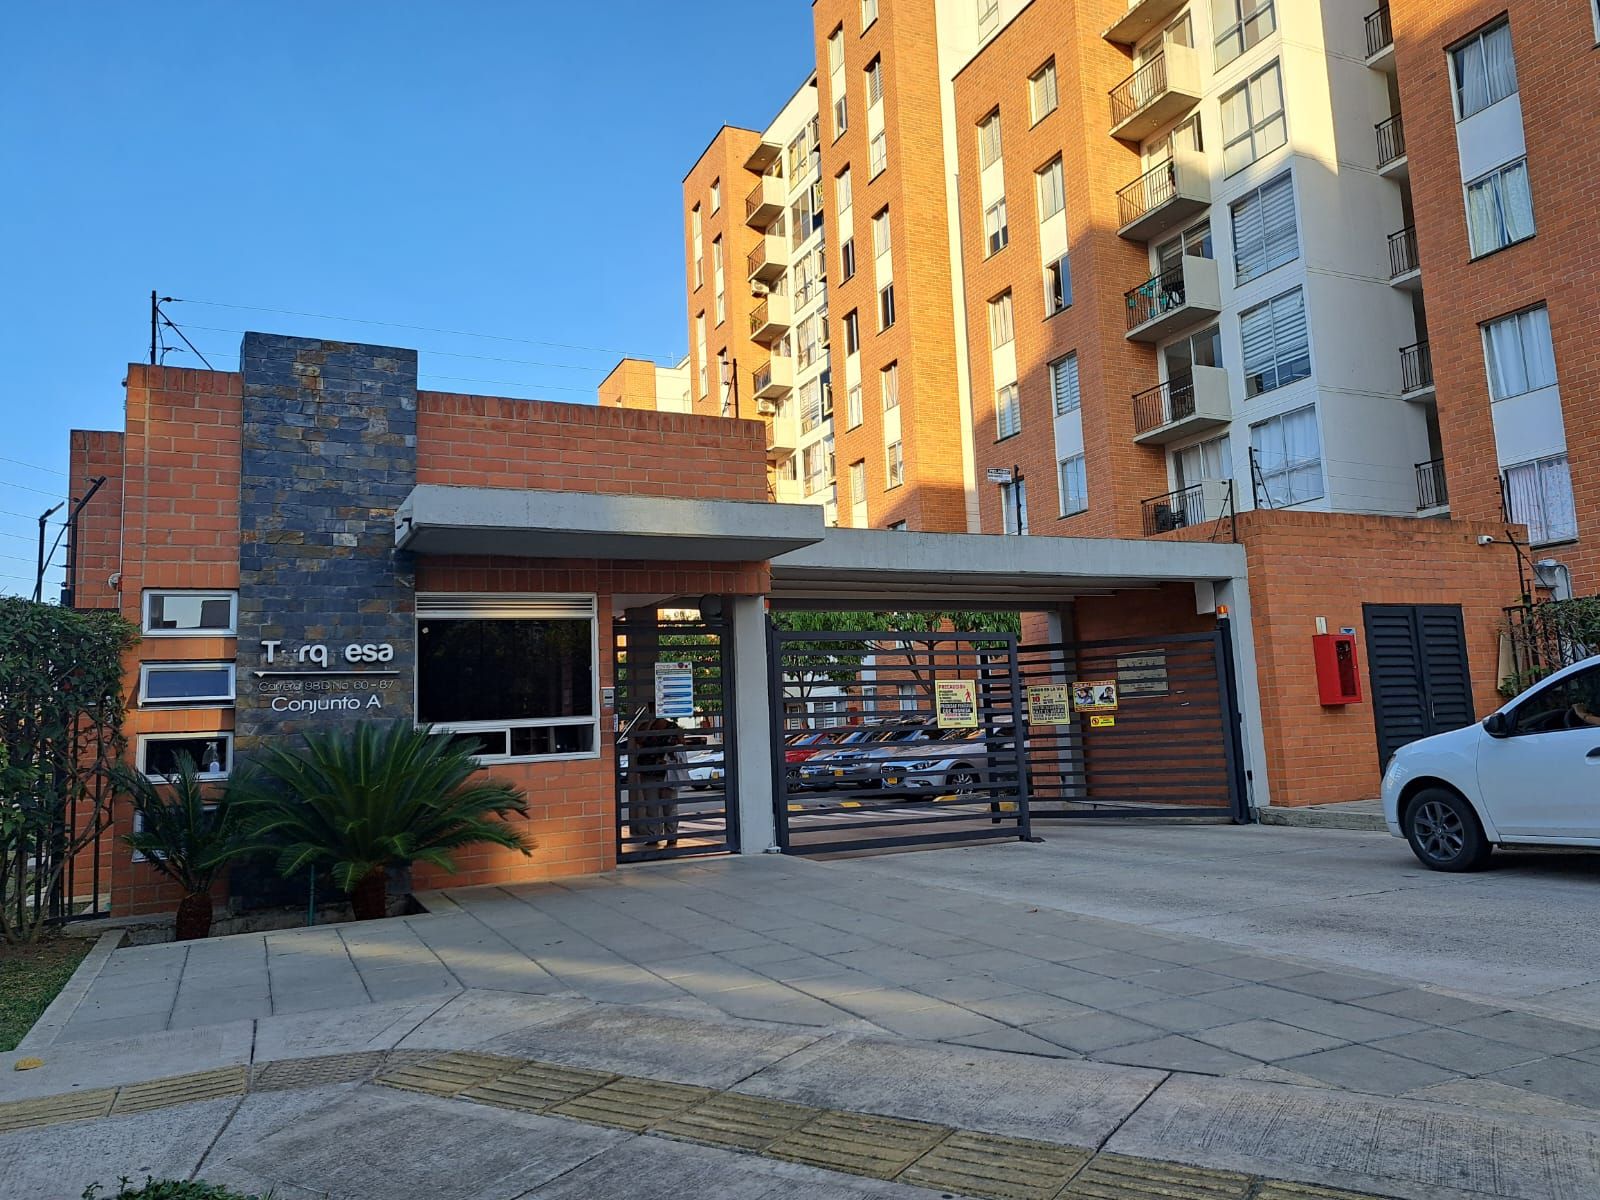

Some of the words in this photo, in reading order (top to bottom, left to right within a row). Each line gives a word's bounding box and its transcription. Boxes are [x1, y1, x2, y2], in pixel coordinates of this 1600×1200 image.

[260, 640, 394, 668] Trqesa
[271, 696, 361, 714] Conjunto
[365, 694, 382, 709] A
